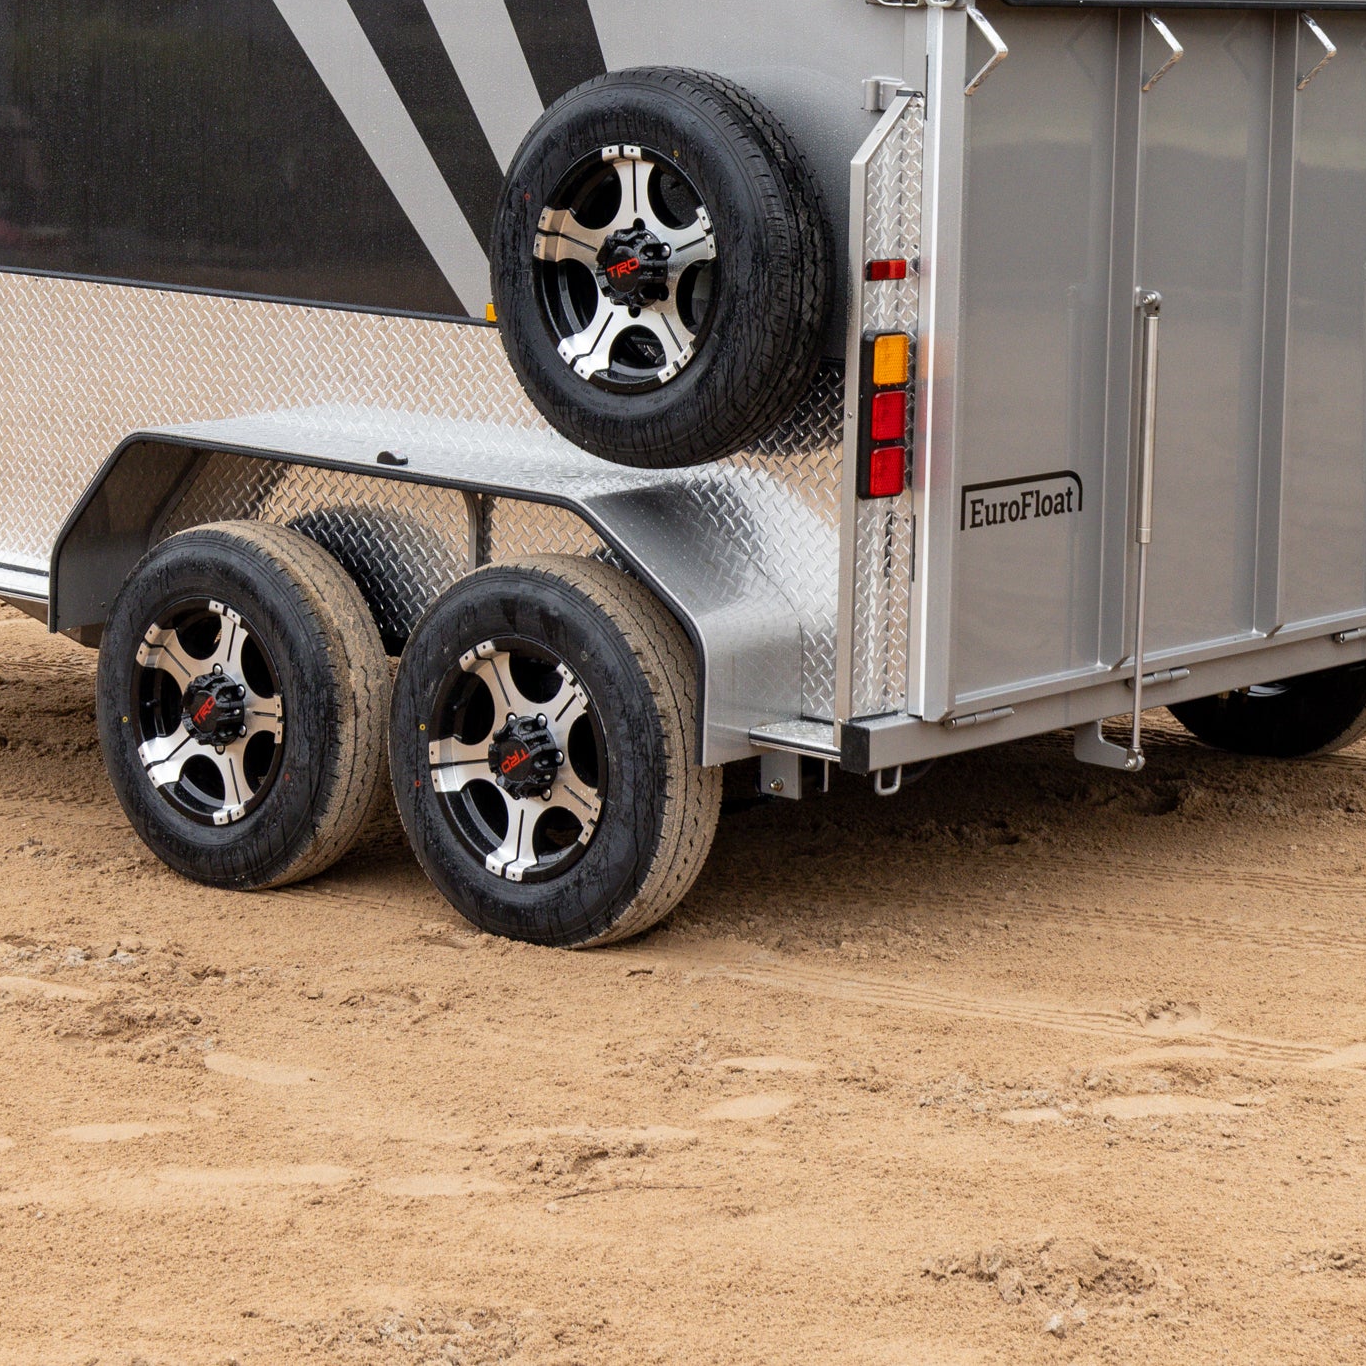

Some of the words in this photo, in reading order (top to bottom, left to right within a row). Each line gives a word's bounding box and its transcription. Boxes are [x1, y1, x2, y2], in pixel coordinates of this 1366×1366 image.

[606, 257, 640, 279] TRD
[969, 486, 1073, 529] EuroFloat
[193, 695, 216, 725] TRD
[500, 748, 530, 774] TRD
